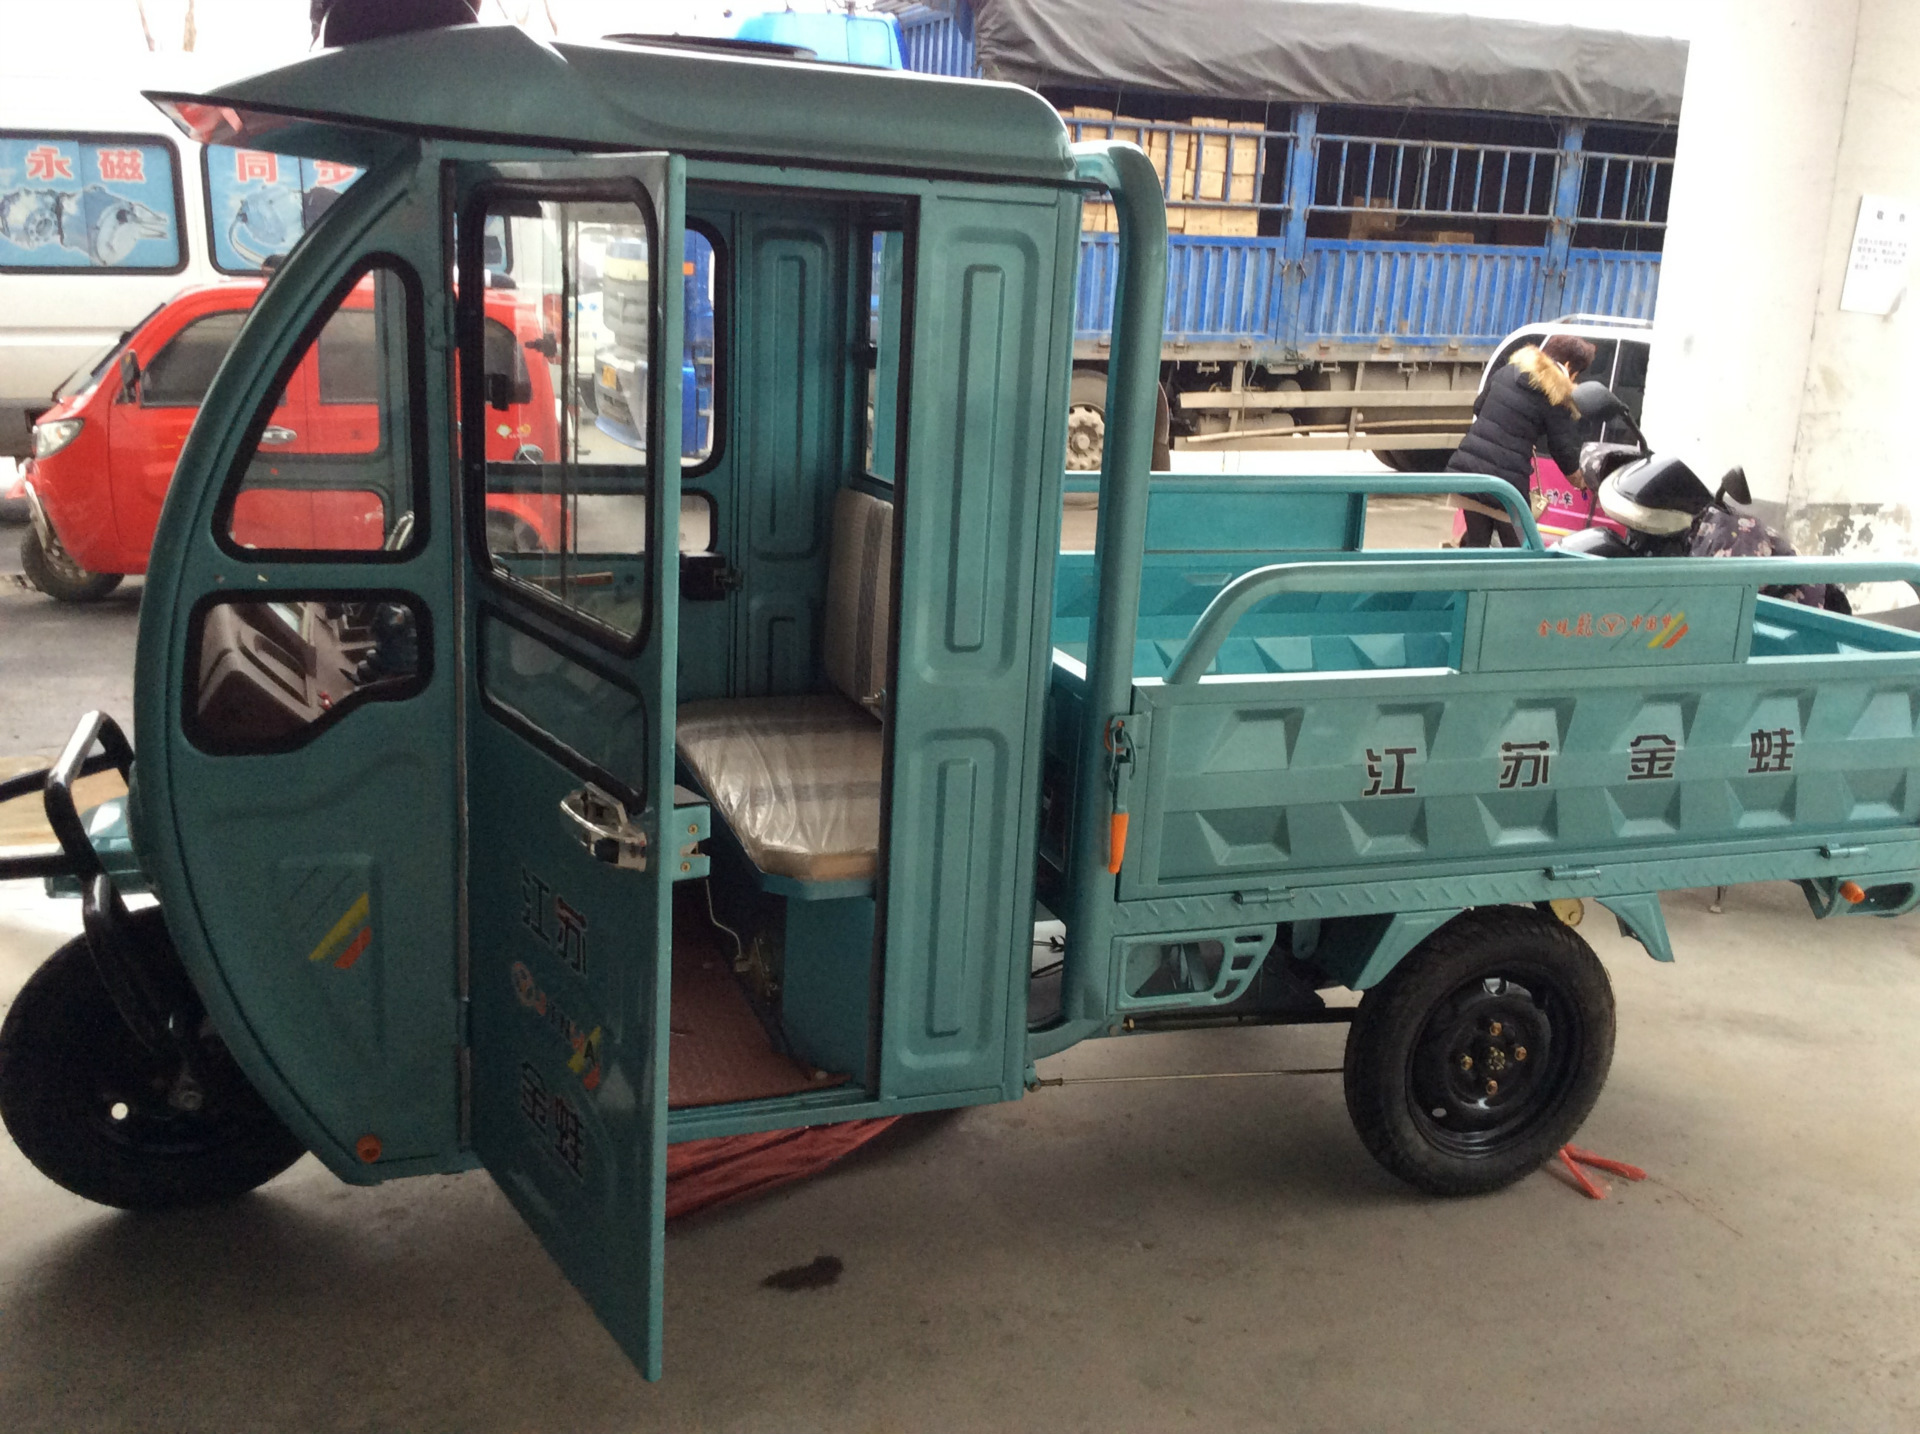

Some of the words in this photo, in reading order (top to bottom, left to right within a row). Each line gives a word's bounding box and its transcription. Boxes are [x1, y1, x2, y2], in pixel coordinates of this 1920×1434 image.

[27, 148, 145, 181] 永磁
[1362, 727, 1796, 797] 江苏金蛙
[520, 863, 588, 976] 江苏
